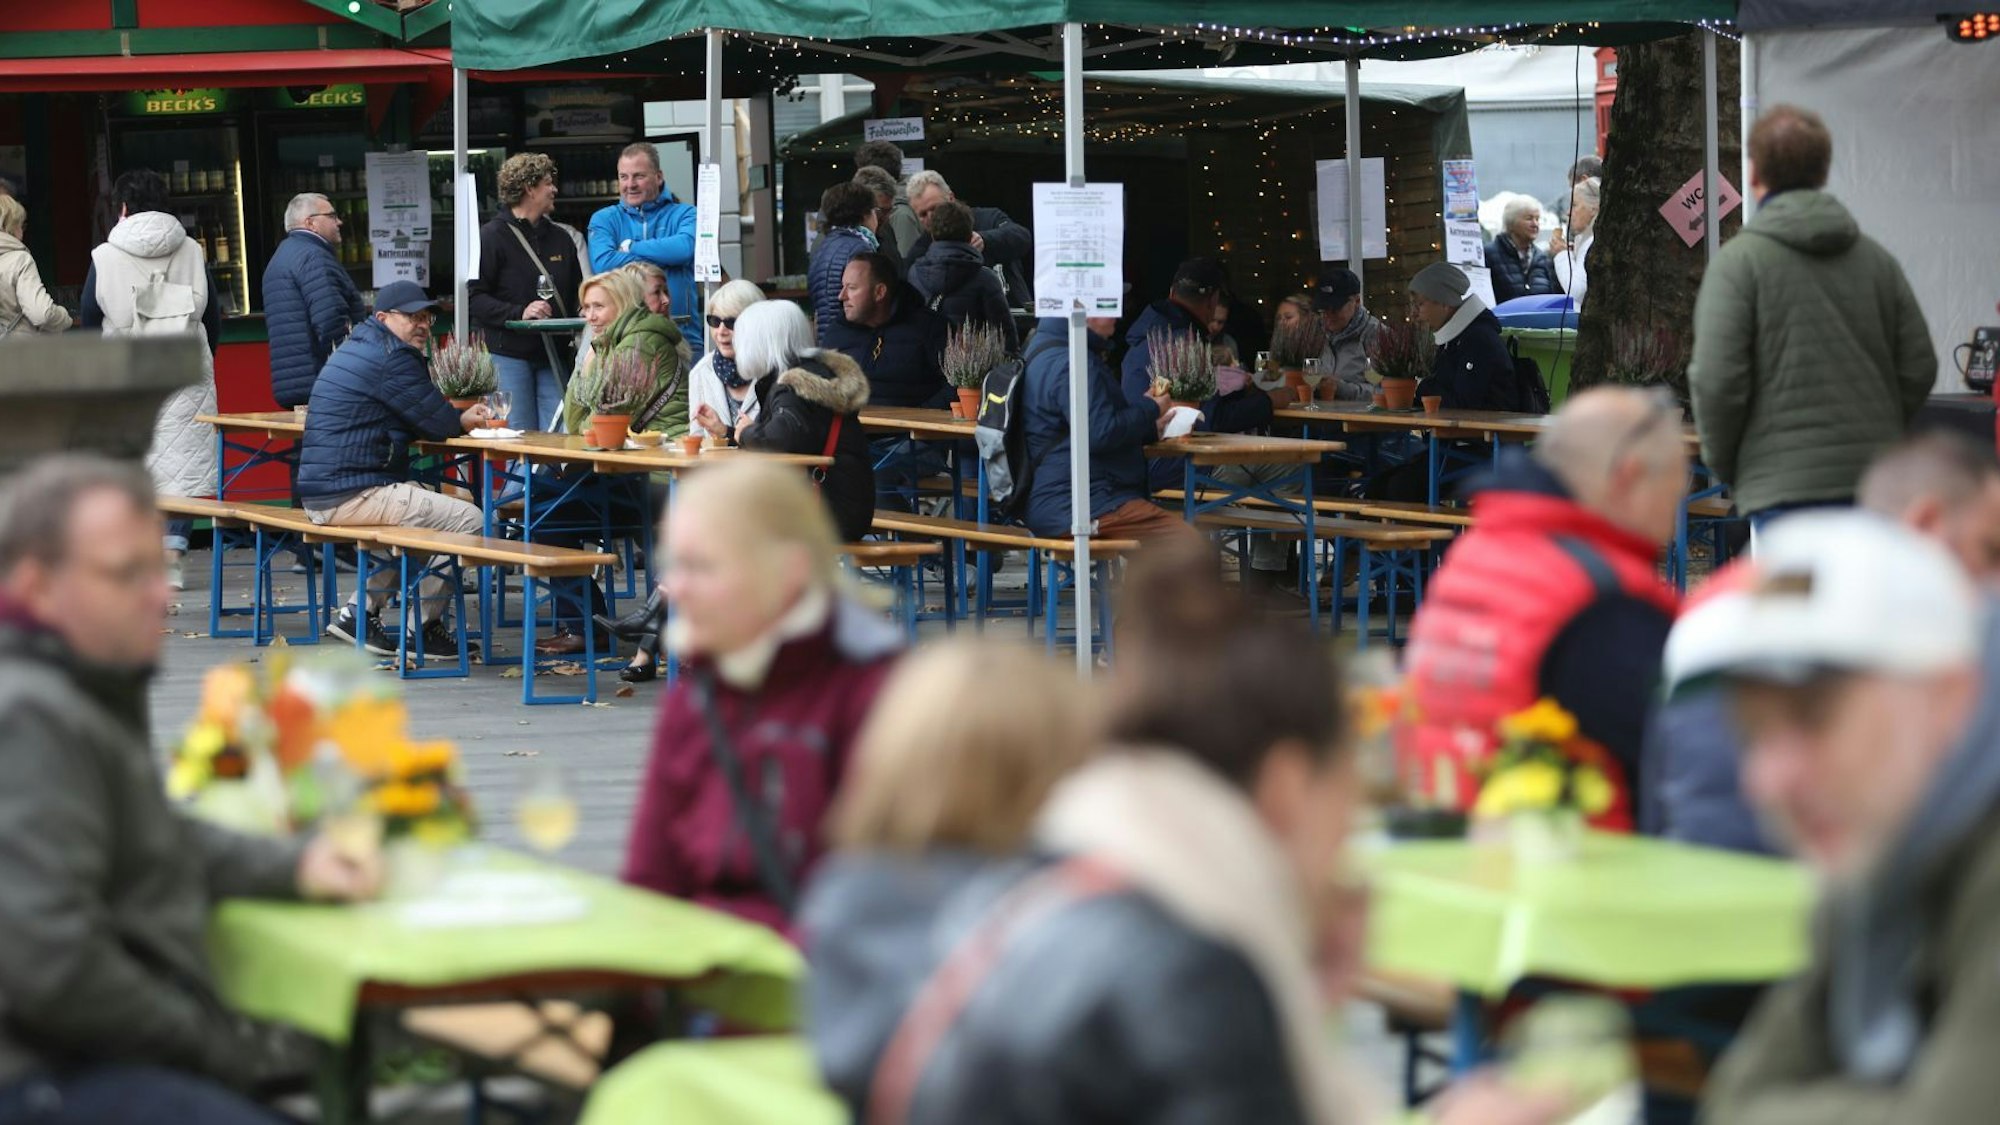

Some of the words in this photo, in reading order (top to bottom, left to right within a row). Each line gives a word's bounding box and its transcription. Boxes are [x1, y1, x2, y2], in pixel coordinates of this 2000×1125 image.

[147, 96, 216, 113] BECK'S
[295, 91, 362, 106] ECK'S
[1681, 187, 1704, 210] WC
